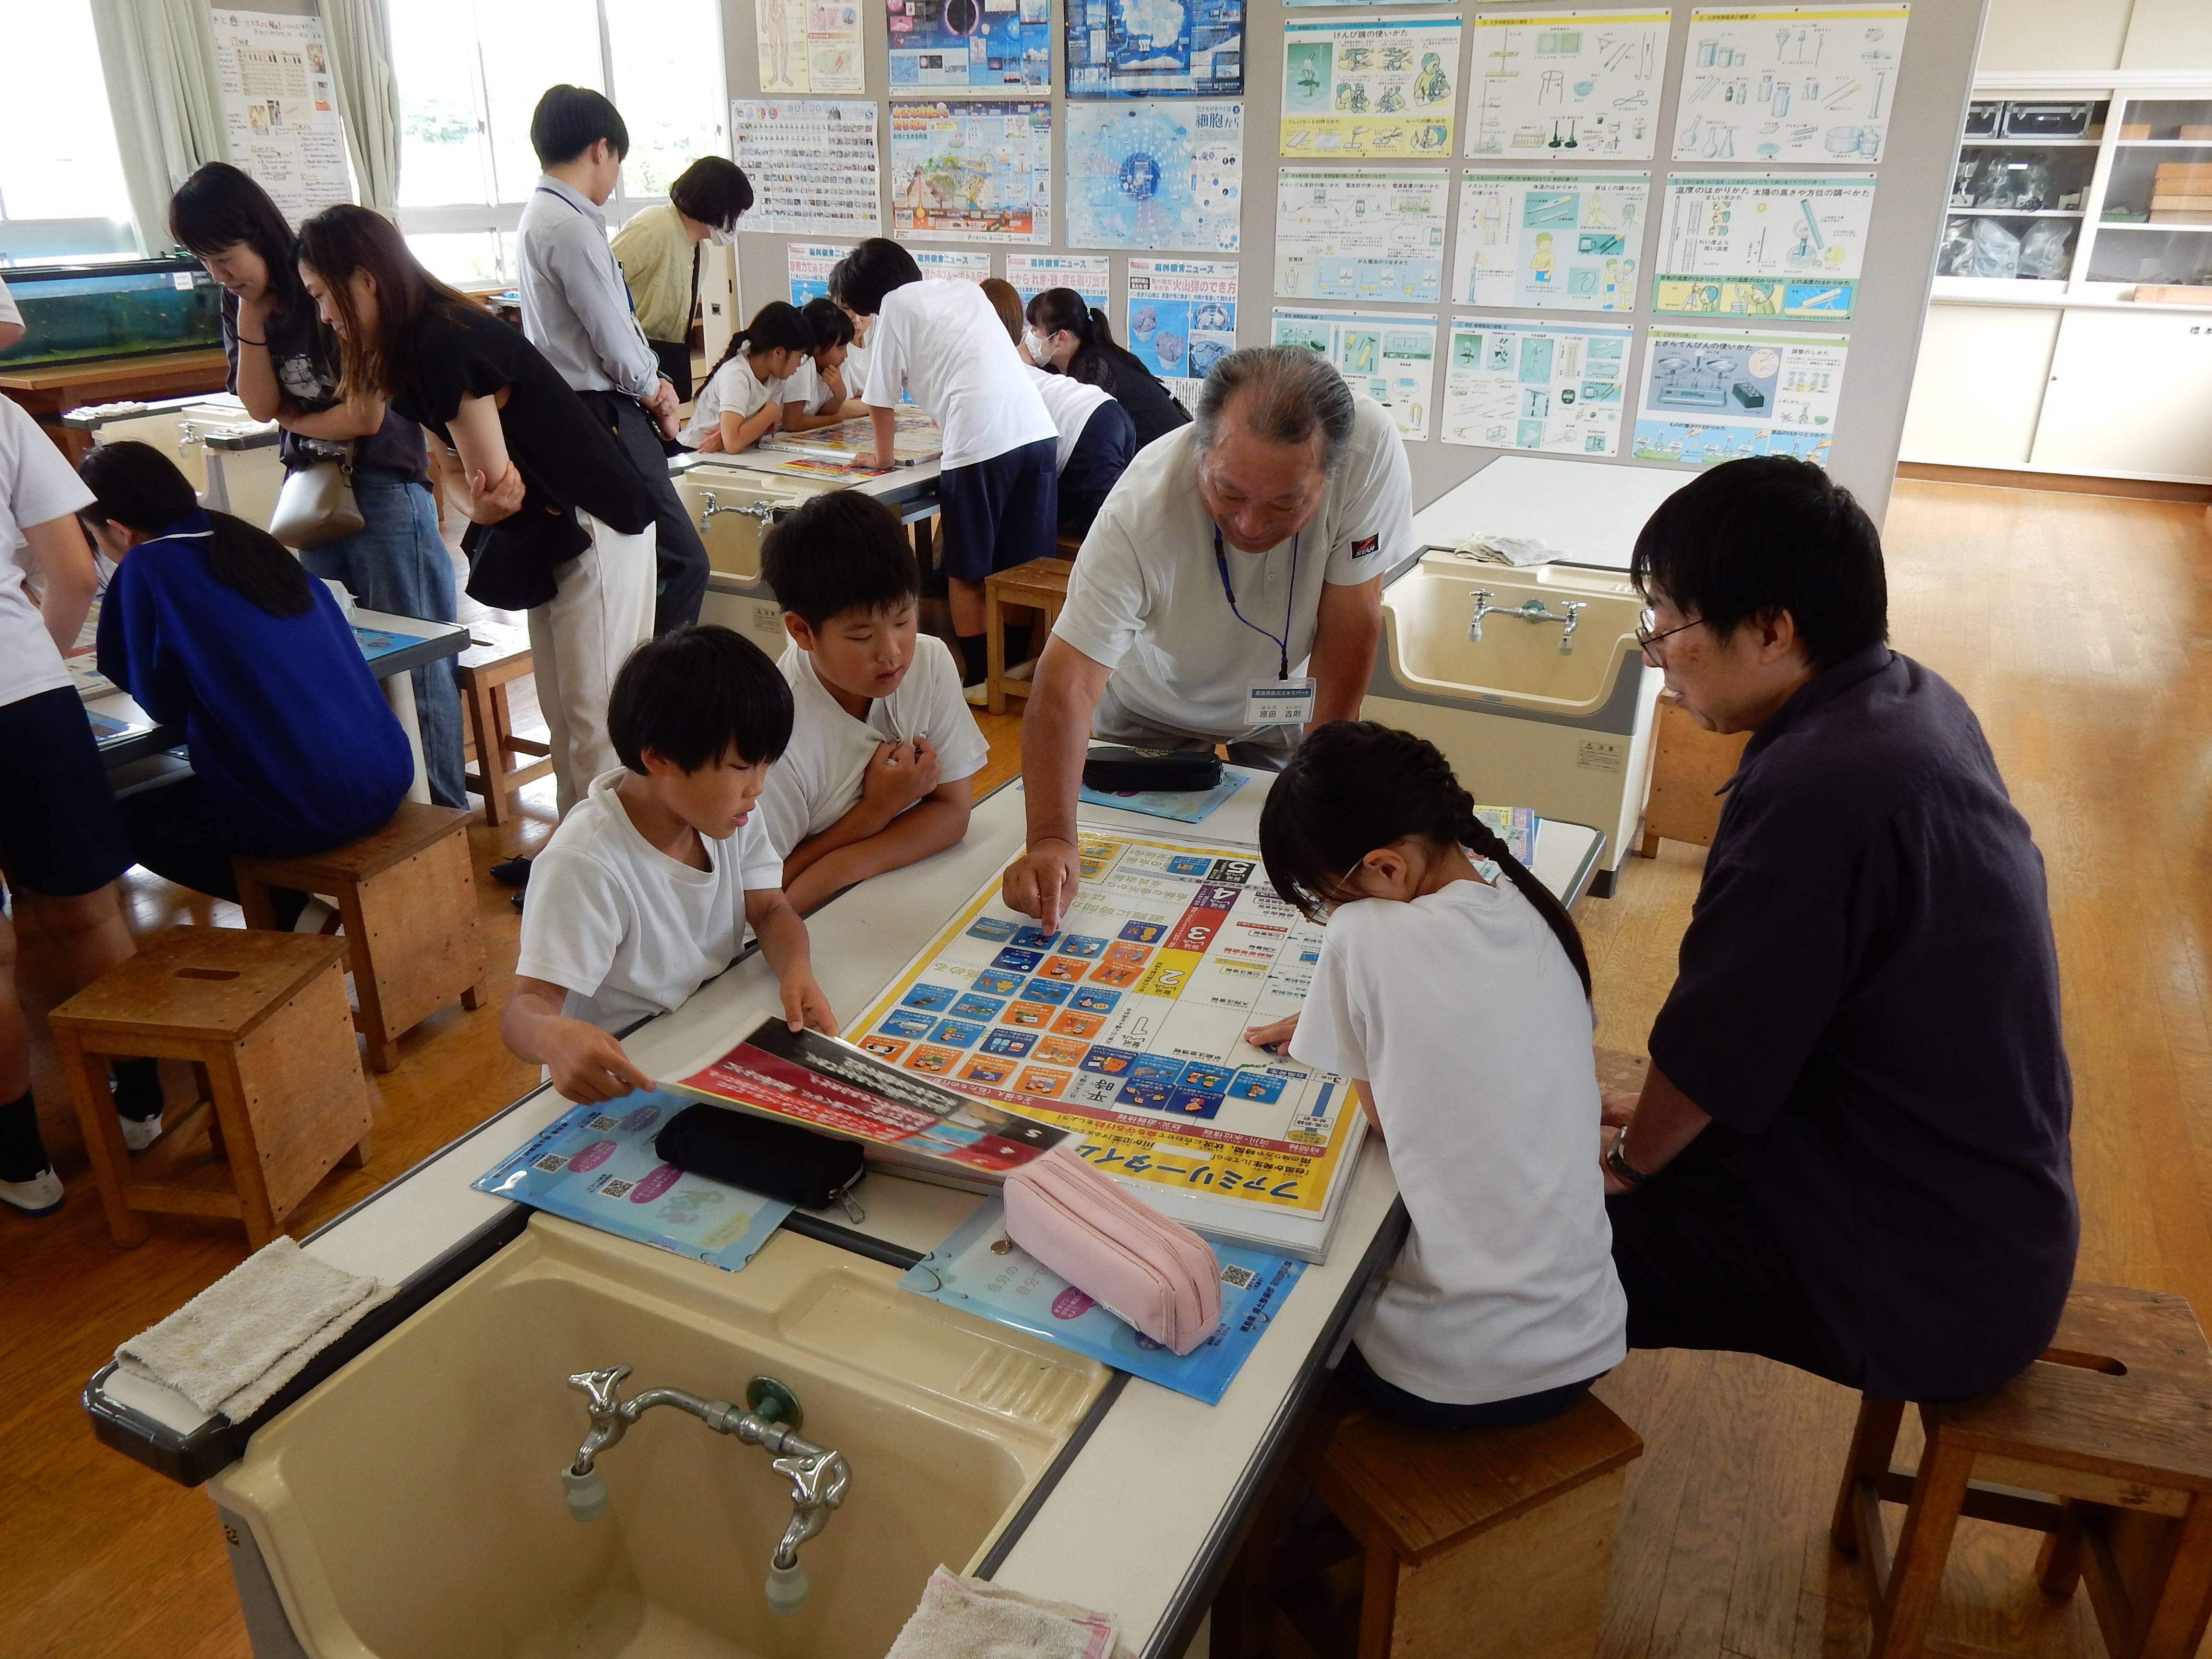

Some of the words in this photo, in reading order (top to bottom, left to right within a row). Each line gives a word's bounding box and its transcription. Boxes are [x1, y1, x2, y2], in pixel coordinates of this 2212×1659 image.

[1334, 30, 1408, 39] けんび鏡の使いかた
[1195, 113, 1239, 128] 細胞から
[1675, 186, 1750, 194] 温度のはかりかた
[1753, 188, 1870, 198] 太陽の高さや方位の調べかた
[918, 254, 969, 264] 理科教育ニュース
[1031, 259, 1086, 269] 理科教育ニュース
[1154, 264, 1214, 274] 理科教育ニュース
[1009, 273, 1029, 285] 土から
[1173, 279, 1236, 294] 火山弾のでき方
[1653, 340, 1753, 351] 上ざらてんびんの使いかた
[1670, 422, 1727, 431] ものの重さのはかりかた
[1771, 430, 1827, 438] 薬品のはかりとりかた
[1355, 545, 1375, 557] STAR
[1226, 861, 1250, 874] 5
[1212, 888, 1237, 900] 4
[1186, 926, 1212, 940] 3
[1158, 968, 1185, 985] 2
[1130, 1016, 1149, 1035] 1
[1121, 1034, 1145, 1043] レベル
[998, 1090, 1034, 1103] 主な備え
[1086, 1079, 1115, 1103] 平時
[1202, 1129, 1270, 1145] 河川・水位情報
[1289, 1143, 1320, 1153] 時間軸
[1076, 1145, 1299, 1199] ファミリータイム
